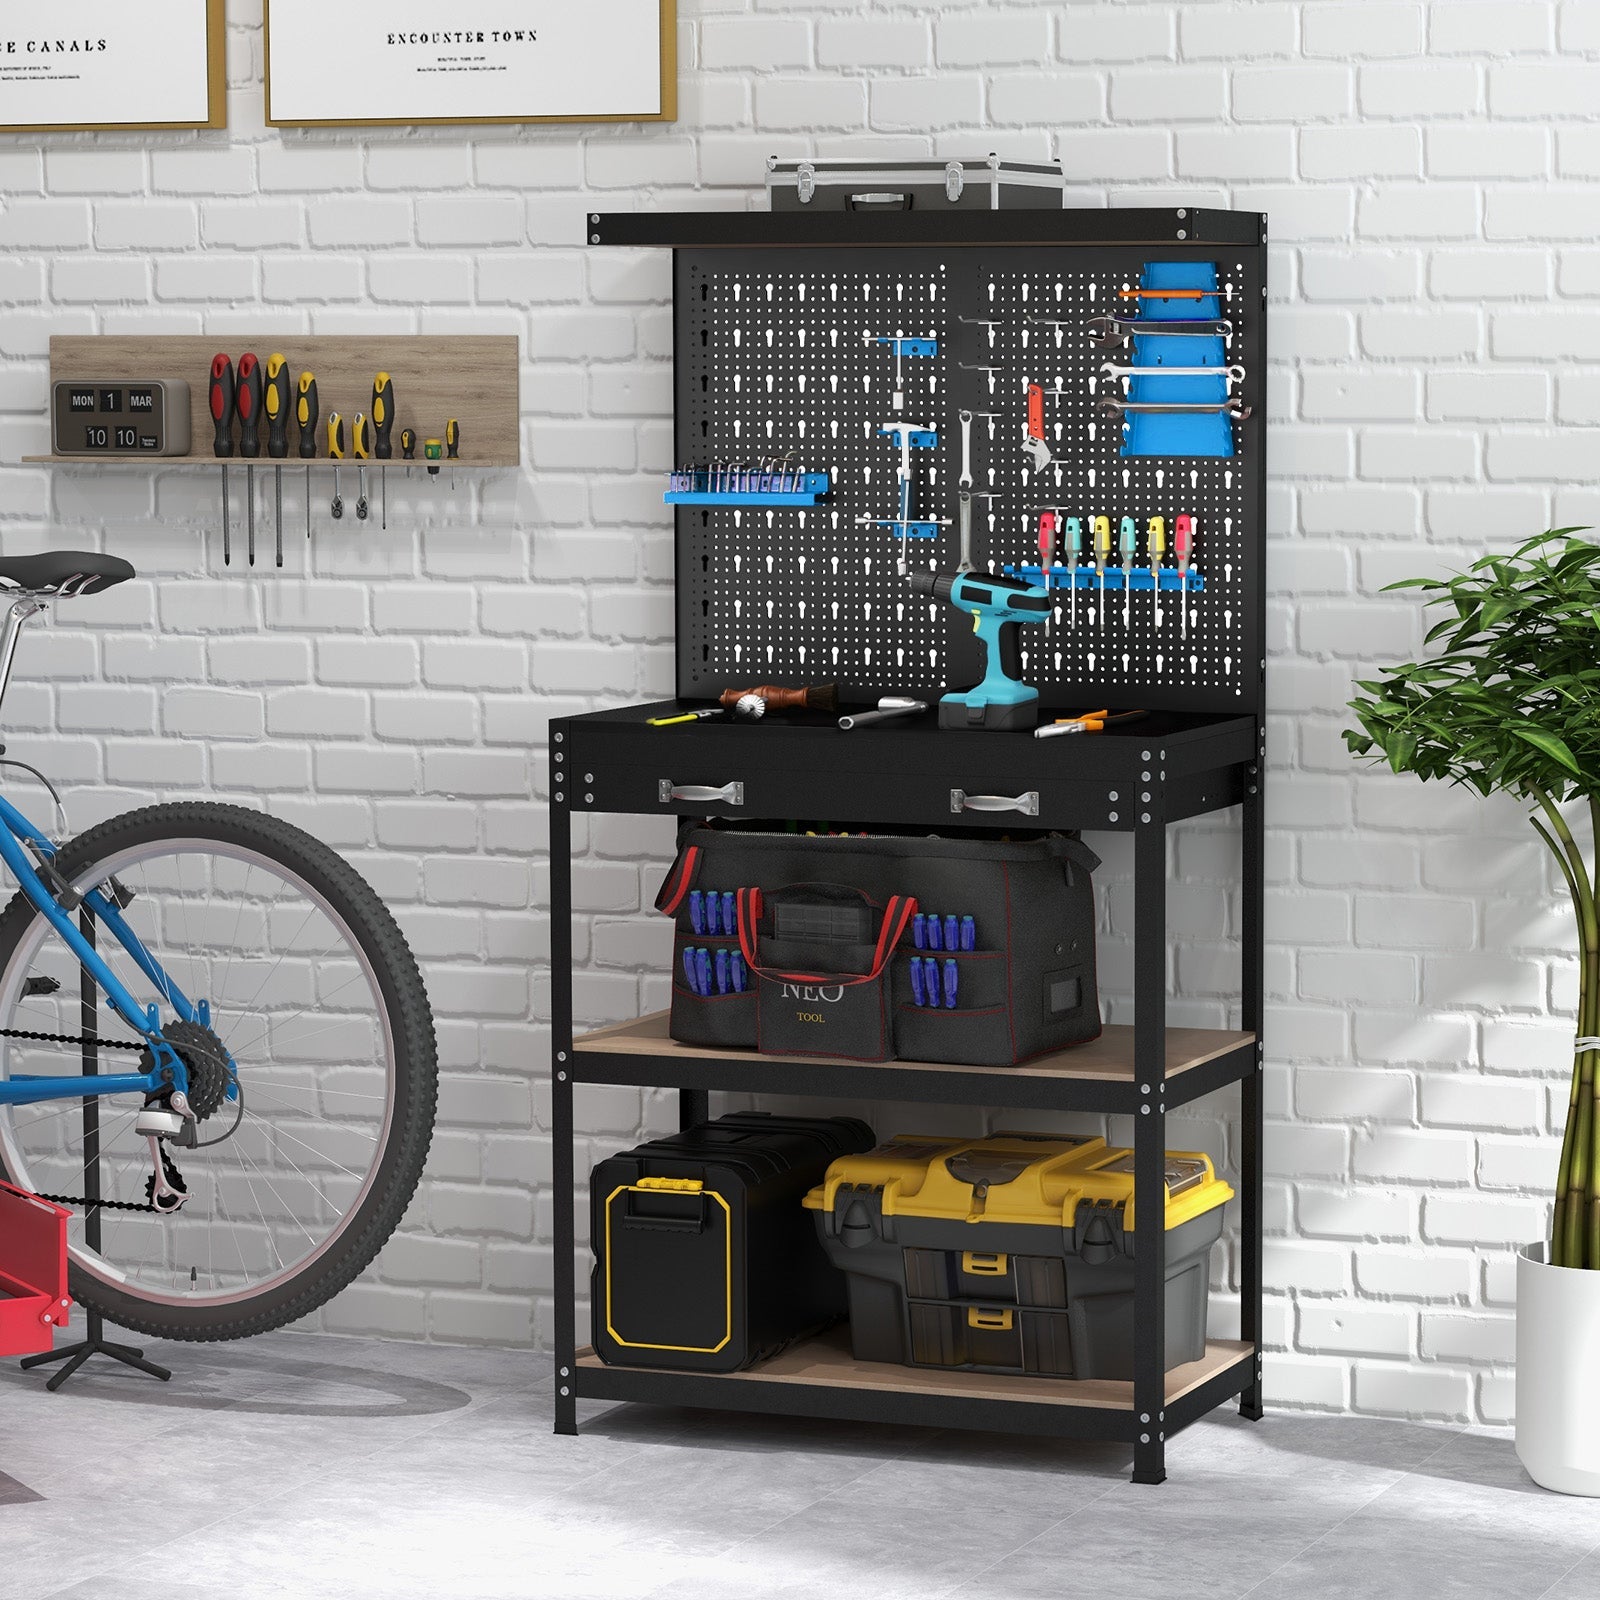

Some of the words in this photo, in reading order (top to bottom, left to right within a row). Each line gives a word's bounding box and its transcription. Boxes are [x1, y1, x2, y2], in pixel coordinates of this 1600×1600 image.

[387, 31, 485, 45] ENCOUNTER
[491, 30, 538, 43] TOWN
[0, 41, 16, 54] E
[26, 39, 107, 53] CANALS
[72, 395, 94, 406] MON
[107, 392, 114, 409] 1
[130, 395, 152, 407] MAR
[88, 429, 106, 445] 10
[117, 429, 135, 445] 10
[781, 984, 844, 1003] NEO
[797, 1012, 825, 1023] TOOL
